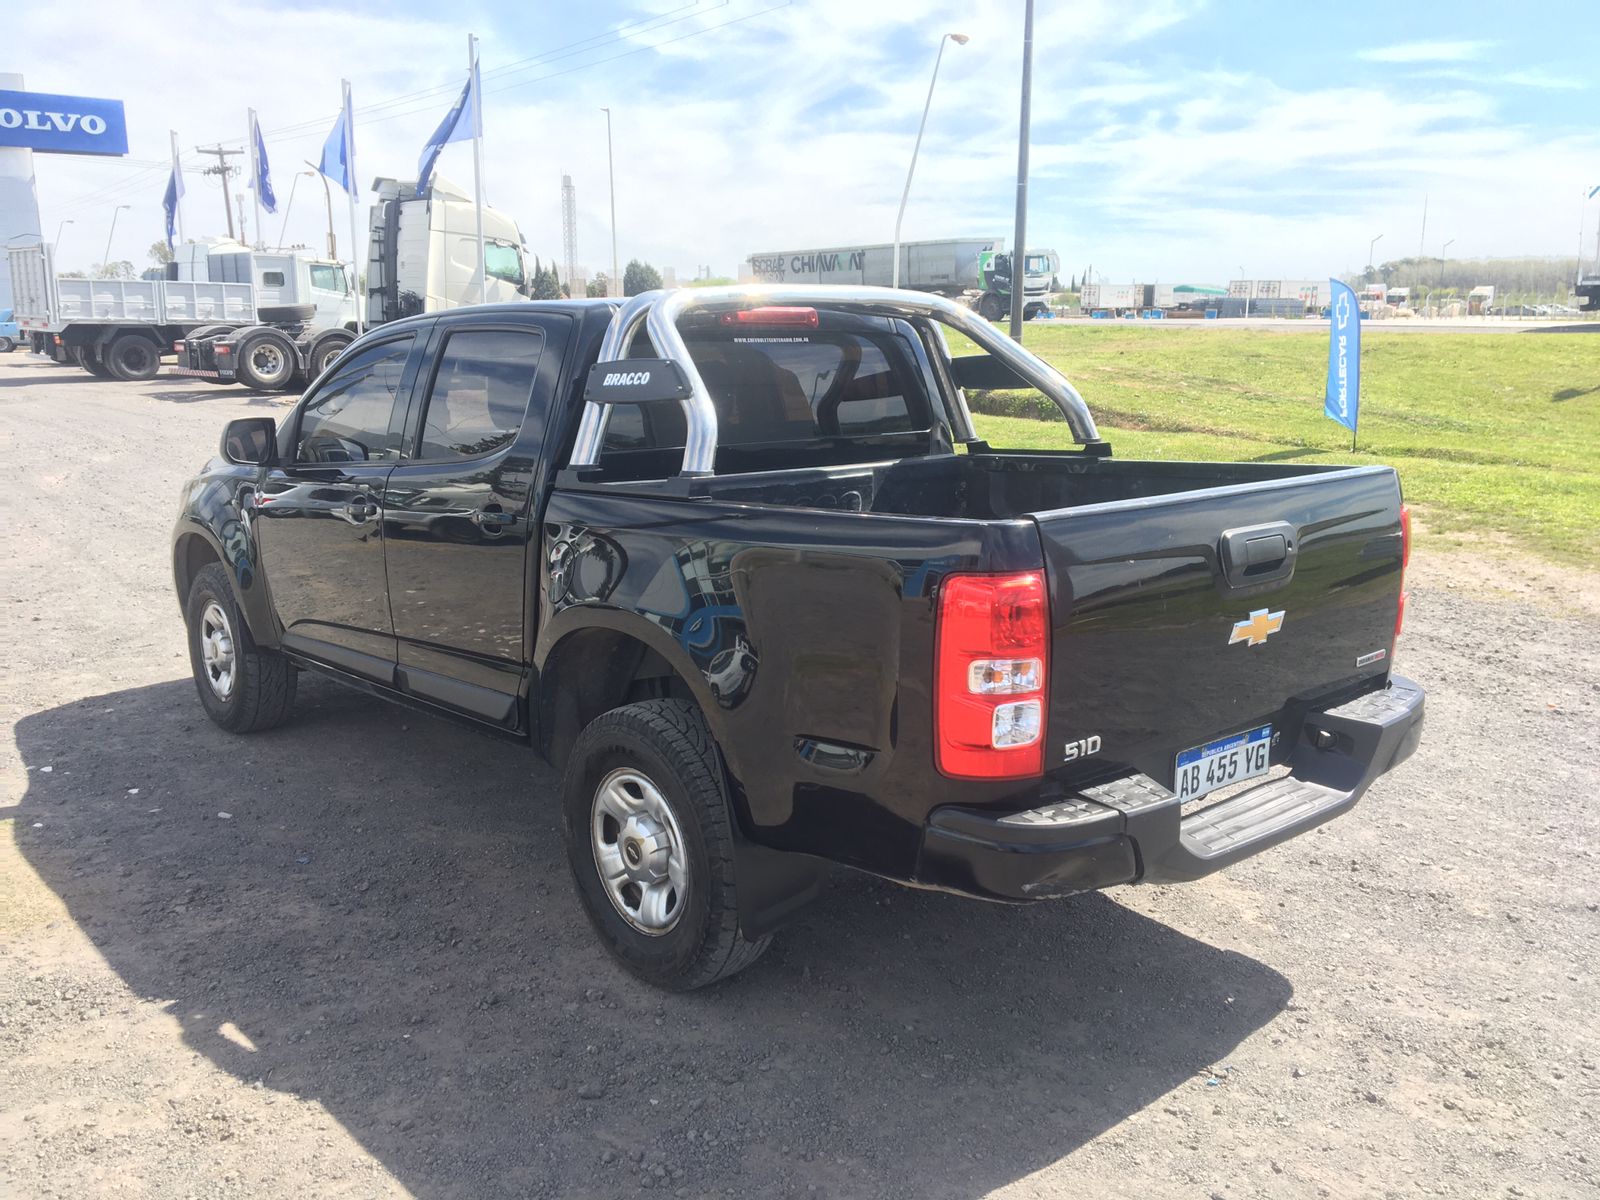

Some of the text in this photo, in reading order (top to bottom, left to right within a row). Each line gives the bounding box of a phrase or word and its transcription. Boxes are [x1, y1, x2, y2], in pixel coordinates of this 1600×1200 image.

[0, 107, 107, 135] OLVO
[602, 371, 650, 386] BRACCO
[1063, 735, 1102, 762] S10
[1180, 743, 1266, 799] AB 455 YG
